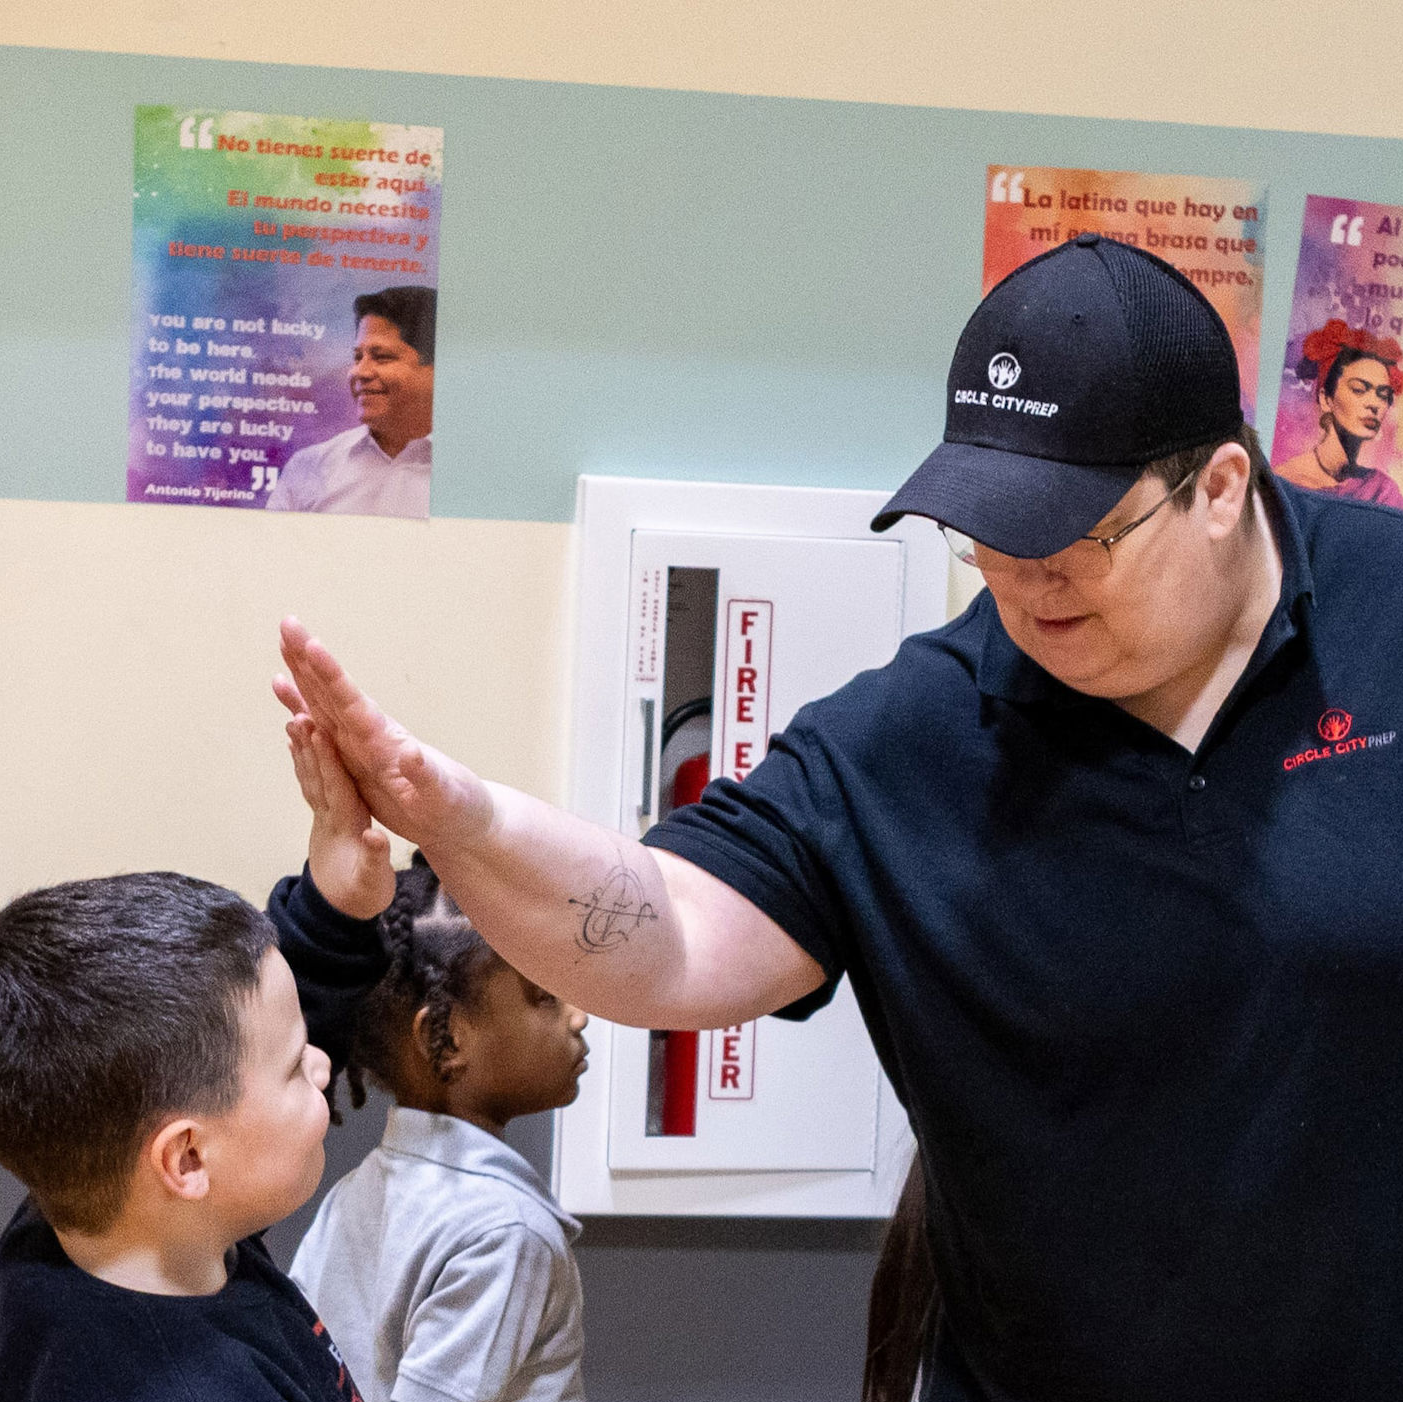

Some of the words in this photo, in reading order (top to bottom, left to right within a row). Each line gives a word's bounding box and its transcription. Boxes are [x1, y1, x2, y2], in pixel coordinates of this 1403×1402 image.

[217, 134, 249, 152] No
[256, 137, 323, 159] tienes
[331, 145, 398, 163] suerte
[405, 149, 431, 166] de
[315, 172, 370, 188] estar
[227, 190, 248, 206] El
[254, 194, 332, 213] mundo
[339, 202, 429, 220] necesita
[1024, 188, 1052, 210] La
[1060, 190, 1128, 213] latina
[1135, 197, 1177, 218] que
[1184, 196, 1226, 222] hay
[1232, 203, 1258, 221] en
[254, 220, 276, 235] tu
[282, 223, 410, 245] perspectiva
[415, 234, 428, 252] y
[1377, 216, 1400, 235] Al
[1030, 222, 1059, 241] mí
[1148, 228, 1208, 250] brasa
[1215, 235, 1257, 254] que
[169, 242, 225, 259] tiene
[232, 247, 300, 265] suerte
[307, 252, 334, 268] de
[192, 317, 226, 330] are
[233, 318, 265, 332] not
[272, 319, 325, 340] lucky
[1365, 307, 1382, 327] lo
[149, 338, 169, 353] to
[176, 339, 201, 354] be
[207, 341, 256, 358] here.
[148, 363, 182, 379] The
[190, 368, 246, 384] world
[252, 371, 312, 388] needs
[147, 392, 192, 406] your
[199, 395, 318, 414] perspective.
[955, 390, 988, 405] CIRCLE
[147, 415, 192, 435] They
[200, 420, 234, 434] are
[240, 419, 294, 441] lucky
[147, 440, 166, 455] to
[173, 442, 222, 459] have
[145, 483, 200, 498] Antonio
[204, 486, 254, 501] Tijerino
[737, 611, 758, 723] FIRE
[1283, 747, 1331, 771] CIRCLE
